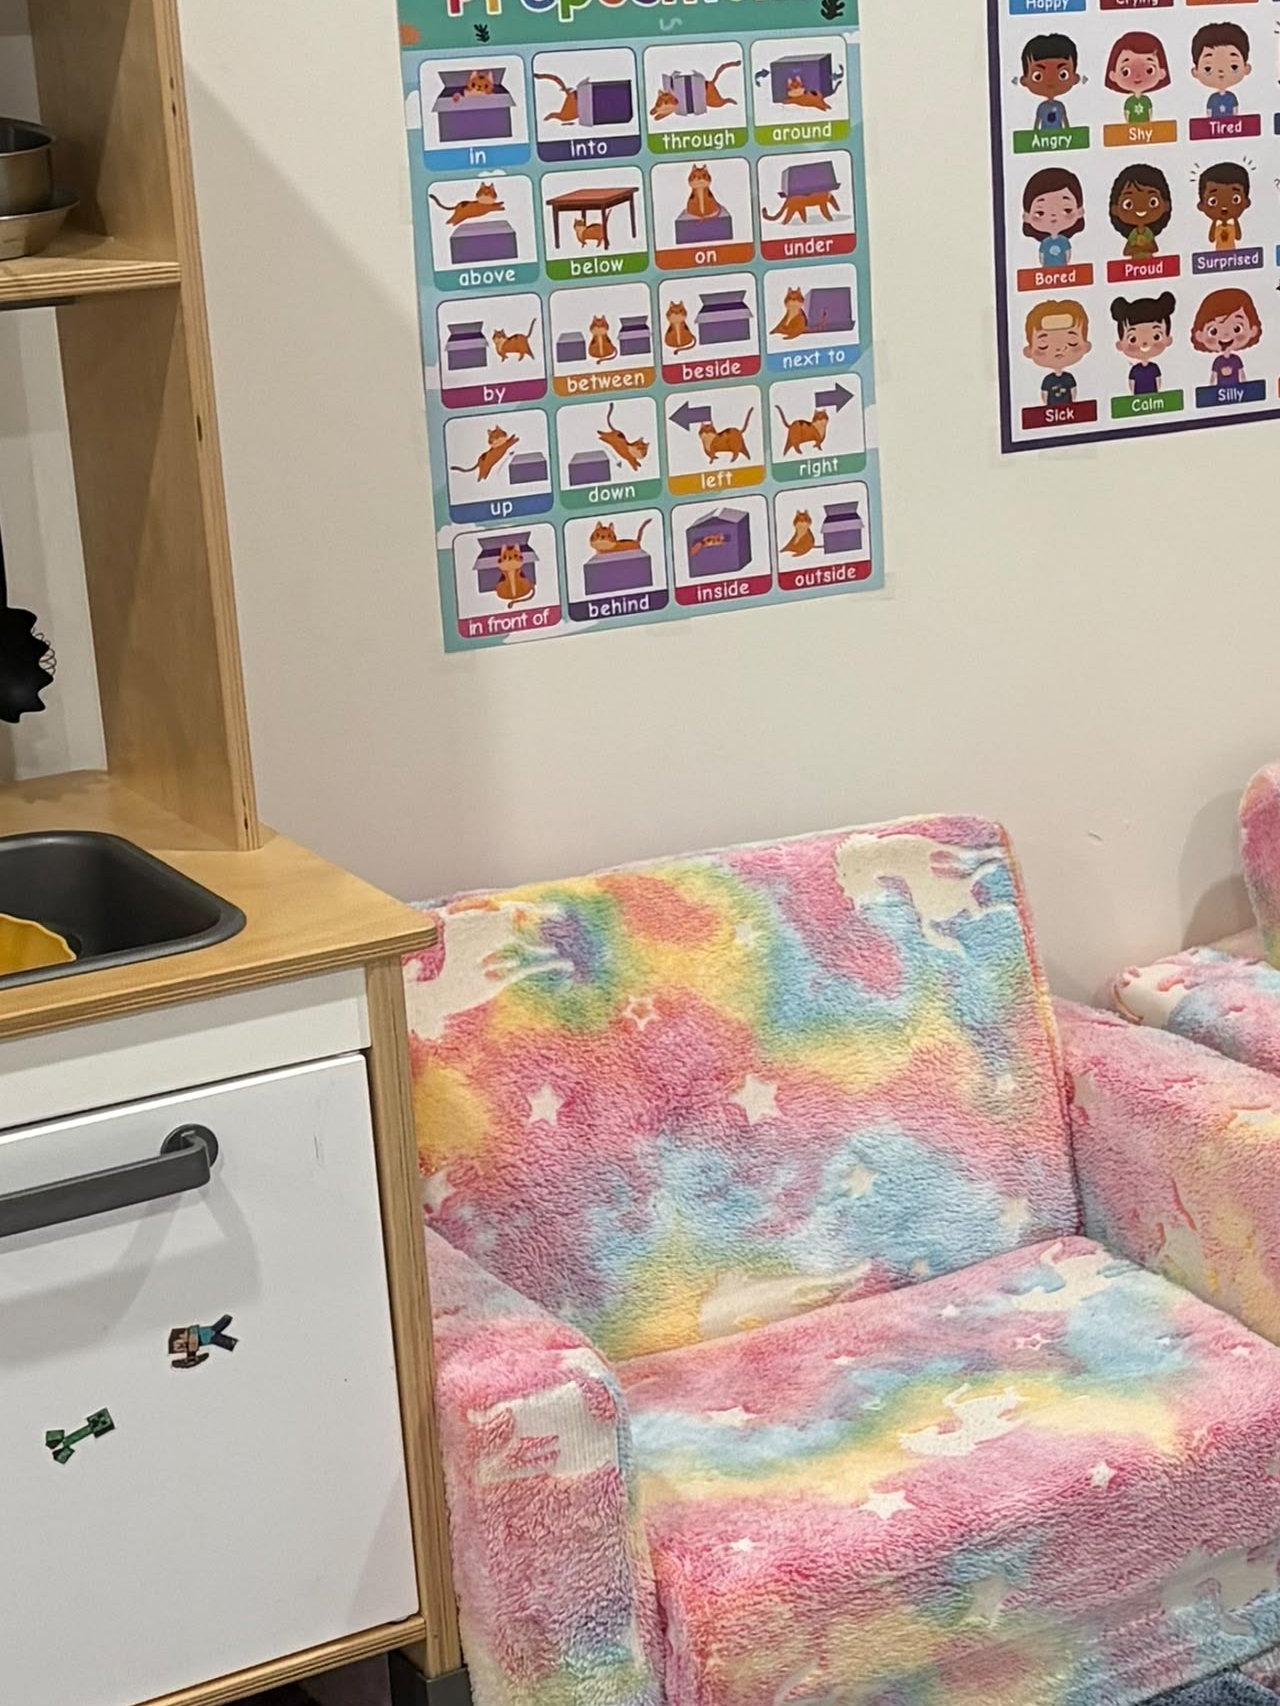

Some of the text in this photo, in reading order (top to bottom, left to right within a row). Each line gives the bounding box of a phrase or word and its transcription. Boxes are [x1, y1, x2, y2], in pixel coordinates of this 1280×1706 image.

[773, 122, 831, 140] around
[1129, 127, 1153, 142] Shy
[1209, 120, 1242, 135] Tired
[571, 140, 607, 156] into
[662, 130, 735, 150] through
[1032, 134, 1072, 149] Angry
[470, 147, 486, 165] in
[784, 238, 833, 255] under
[695, 250, 717, 264] on
[1197, 252, 1259, 269] Surprised
[570, 258, 623, 275] below
[1125, 261, 1163, 277] Proud
[459, 269, 515, 286] above
[1035, 269, 1076, 286] Bored
[783, 349, 845, 368] next to
[682, 360, 741, 380] beside
[567, 373, 648, 391] between
[483, 385, 506, 405] by
[1218, 388, 1244, 401] Silly
[1131, 398, 1164, 412] Calm
[1045, 408, 1074, 422] Sick
[801, 458, 838, 479] right
[702, 471, 733, 488] left
[588, 484, 635, 502] down
[491, 501, 513, 517] up
[796, 566, 856, 586] outside
[698, 582, 749, 601] inside
[589, 595, 649, 616] behind
[468, 609, 549, 634] in front of
